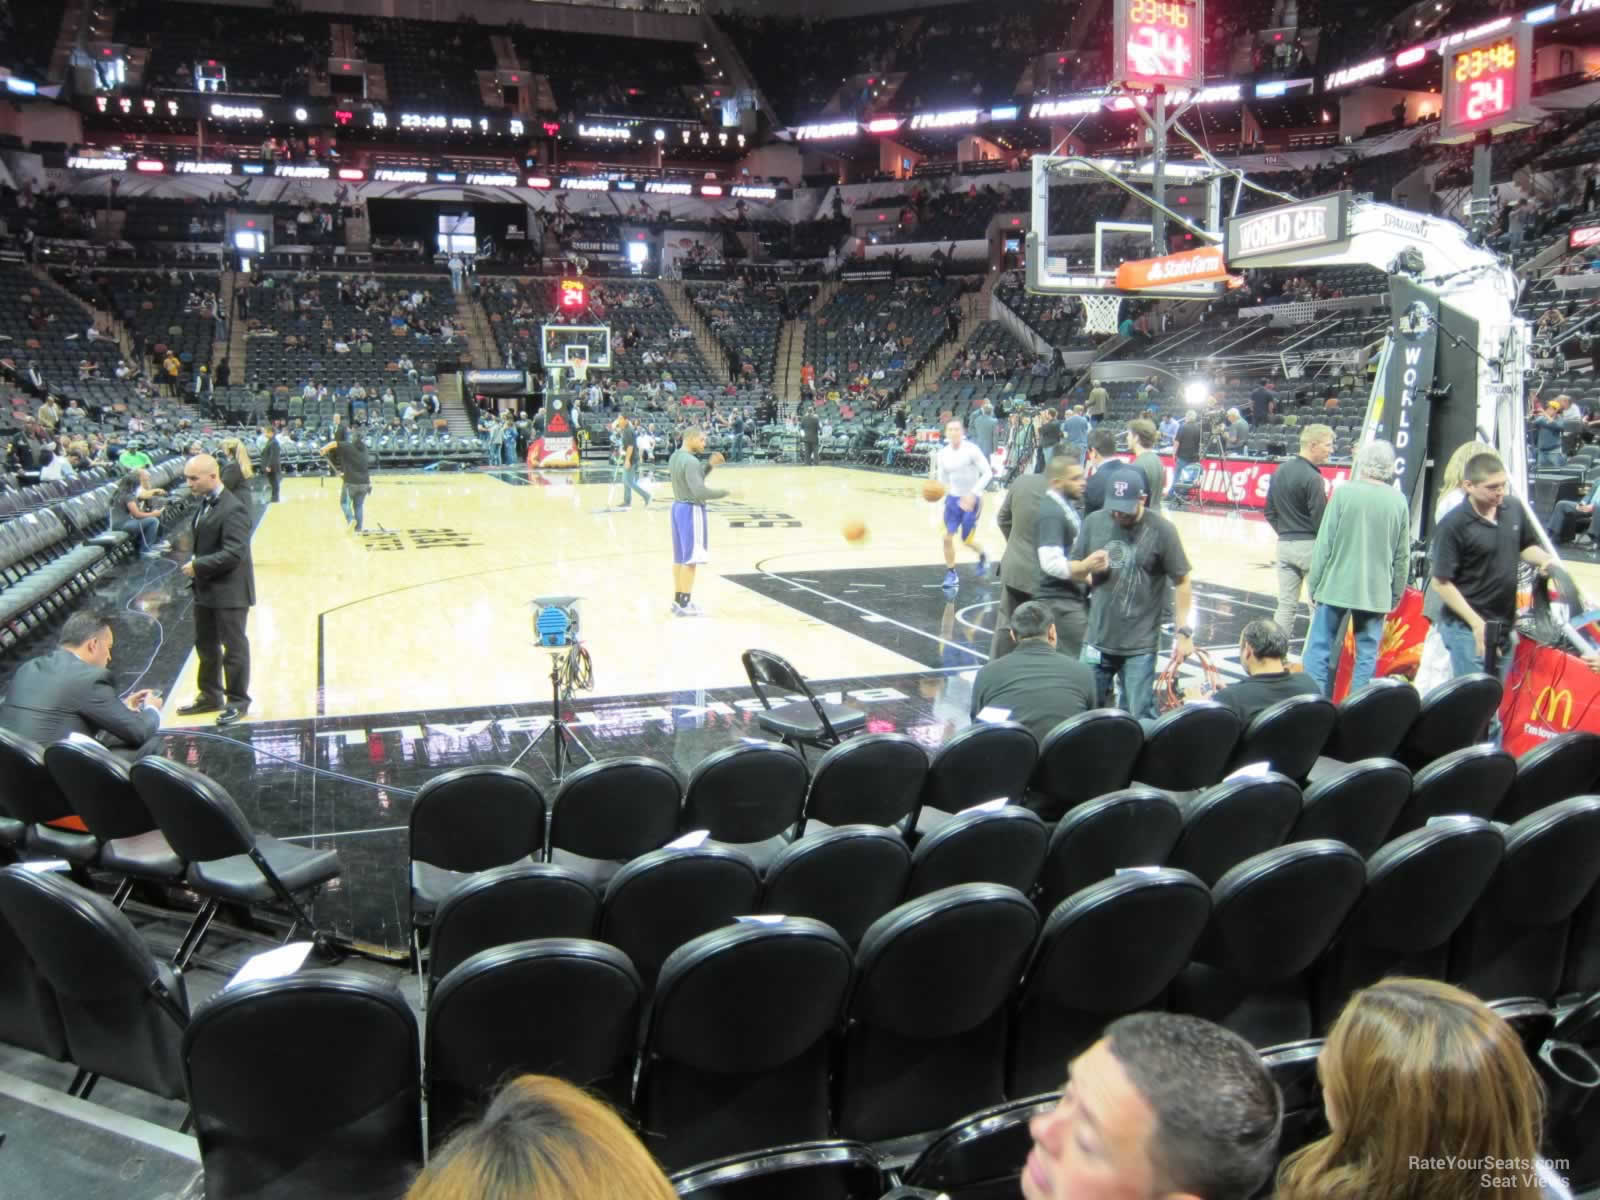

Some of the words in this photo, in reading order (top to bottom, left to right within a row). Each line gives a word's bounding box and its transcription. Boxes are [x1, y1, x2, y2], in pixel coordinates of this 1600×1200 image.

[1131, 0, 1189, 29] 23:46
[1456, 43, 1516, 83] 23:46
[210, 103, 264, 119] Spurs
[1467, 77, 1504, 121] 24
[1240, 213, 1290, 250] WORLD
[1294, 210, 1326, 240] CAR
[1383, 212, 1429, 238] SPALDING
[563, 290, 582, 305] 24
[1395, 346, 1422, 449] WORLD
